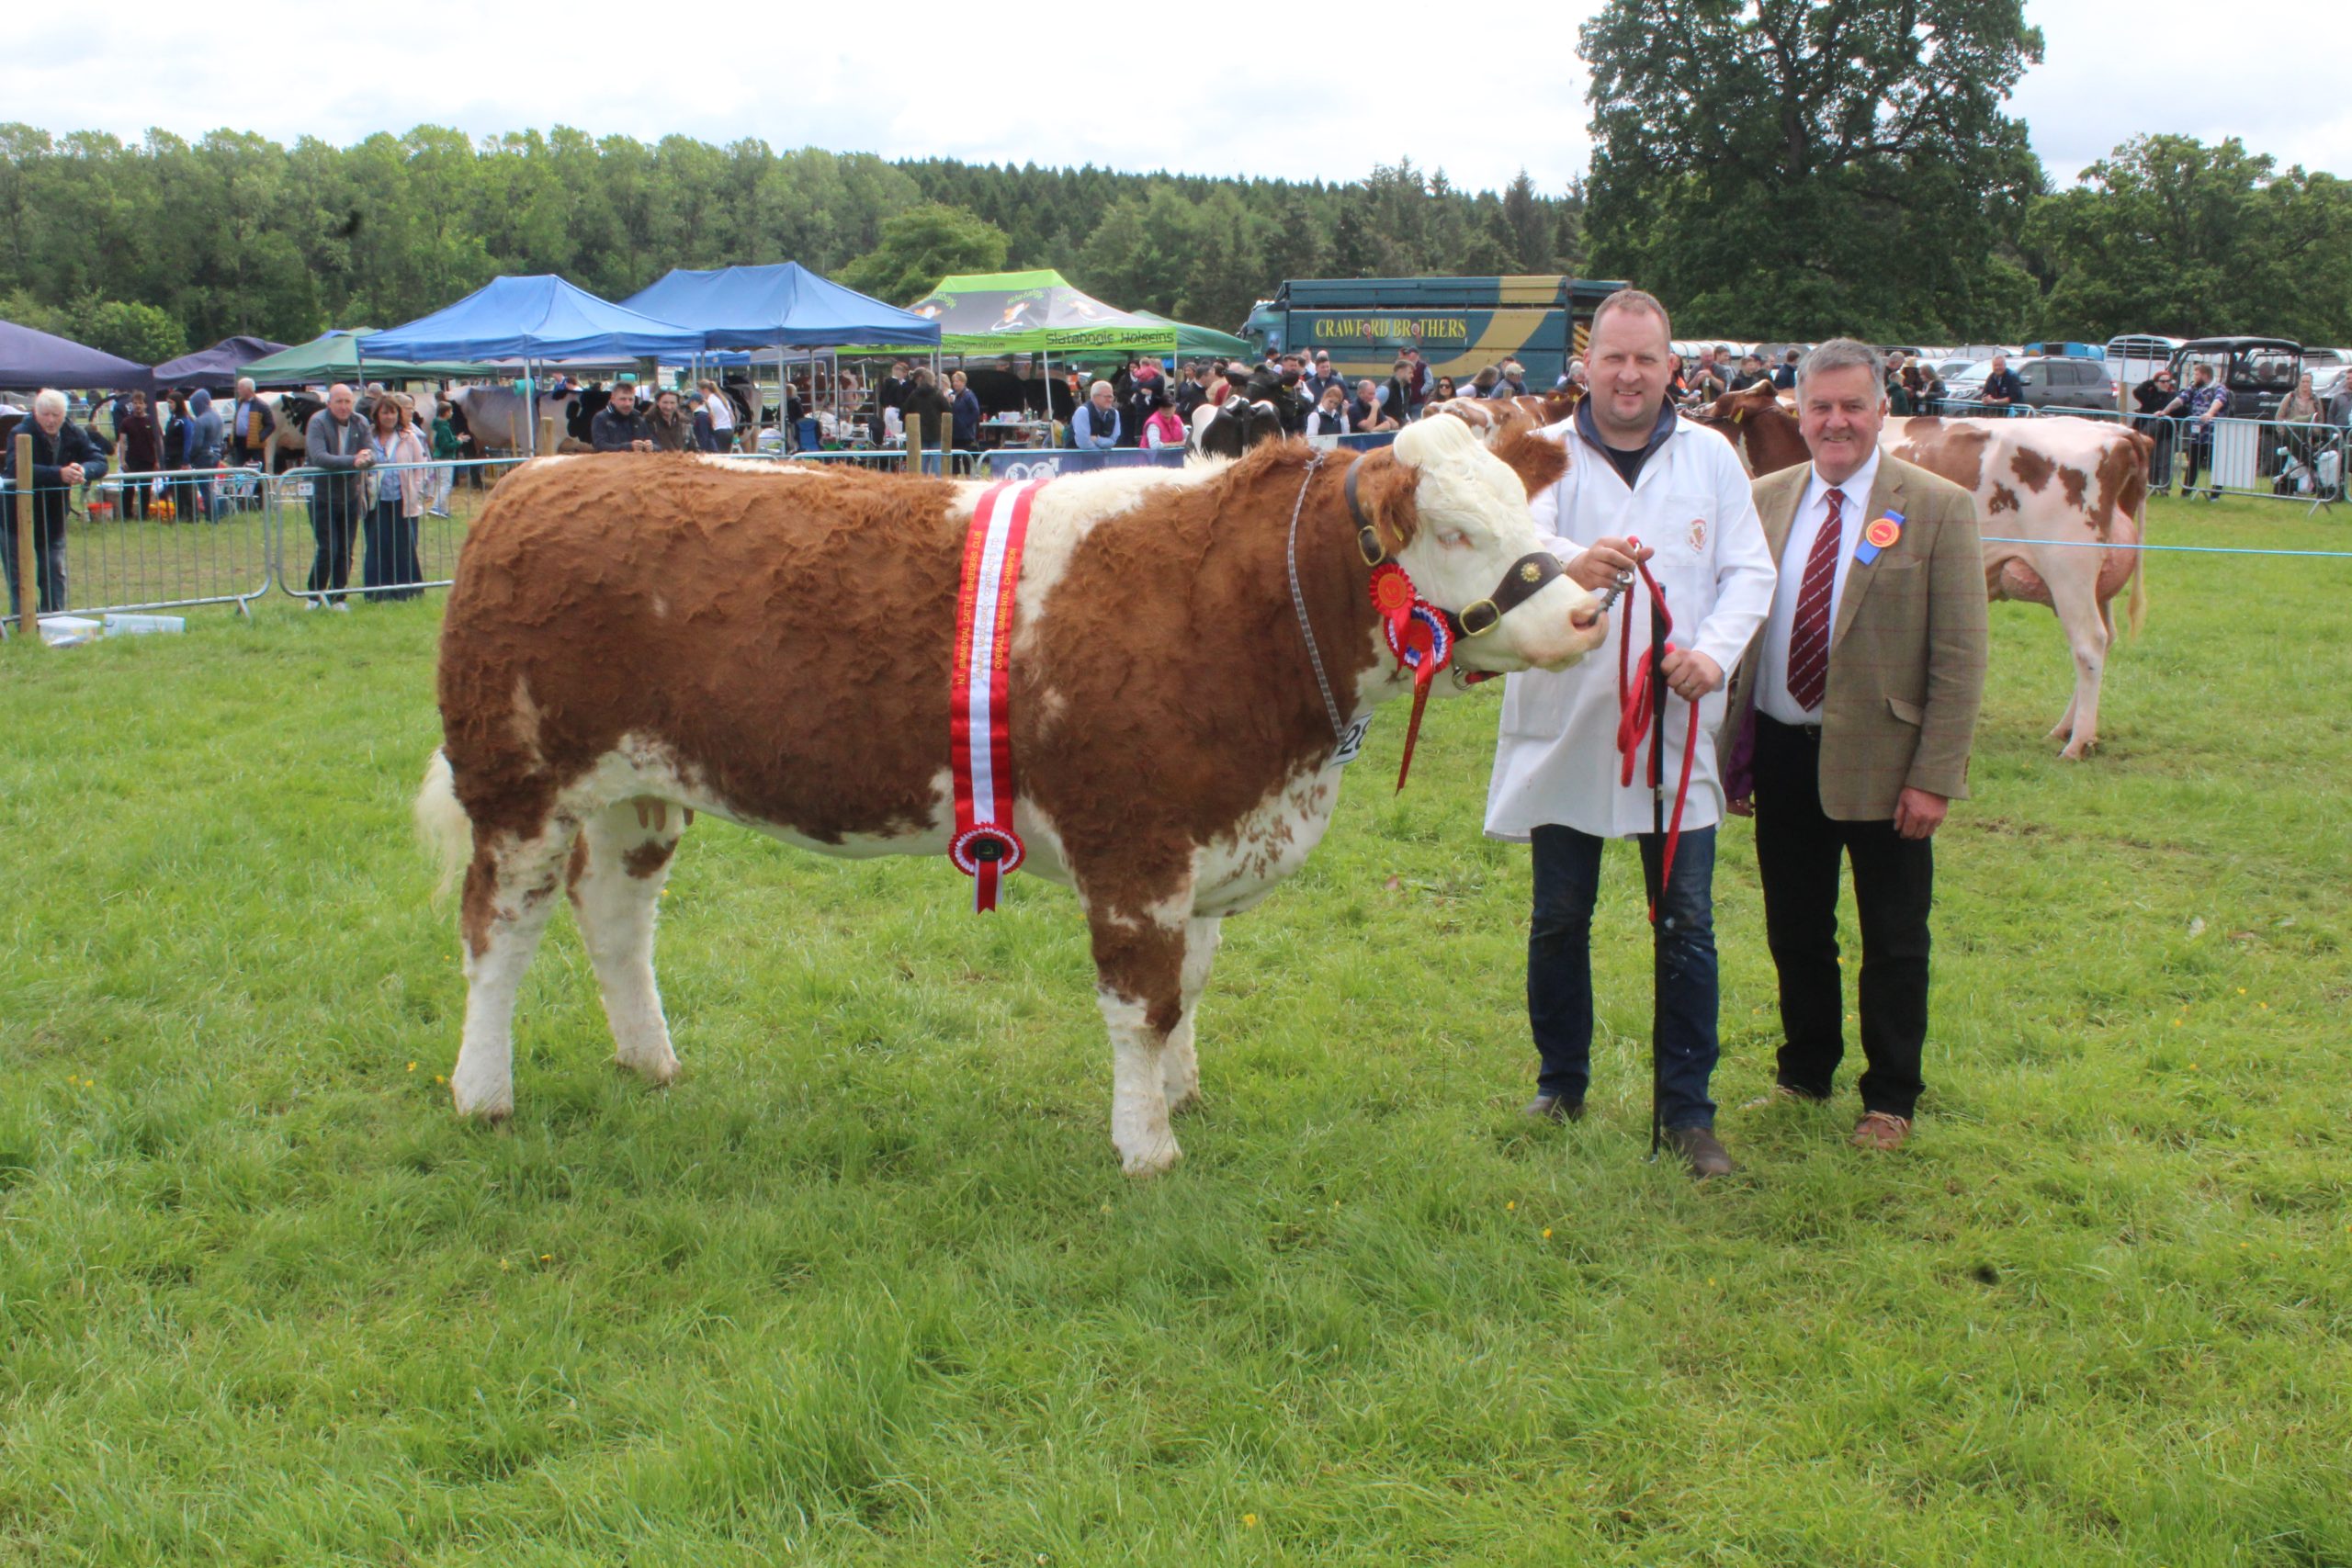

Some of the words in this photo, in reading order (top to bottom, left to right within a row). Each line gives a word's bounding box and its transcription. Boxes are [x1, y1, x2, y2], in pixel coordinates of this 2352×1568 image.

[1316, 319, 1389, 339] CRAWFORD
[1393, 319, 1467, 339] BROTHERS
[972, 531, 983, 548] CLUB
[967, 551, 978, 592] BREEDERS
[1003, 547, 1017, 586] CHAMPION
[963, 594, 973, 623] CATTLE
[998, 588, 1011, 631] SIMMENTAL
[994, 633, 1005, 670] OVERALL
